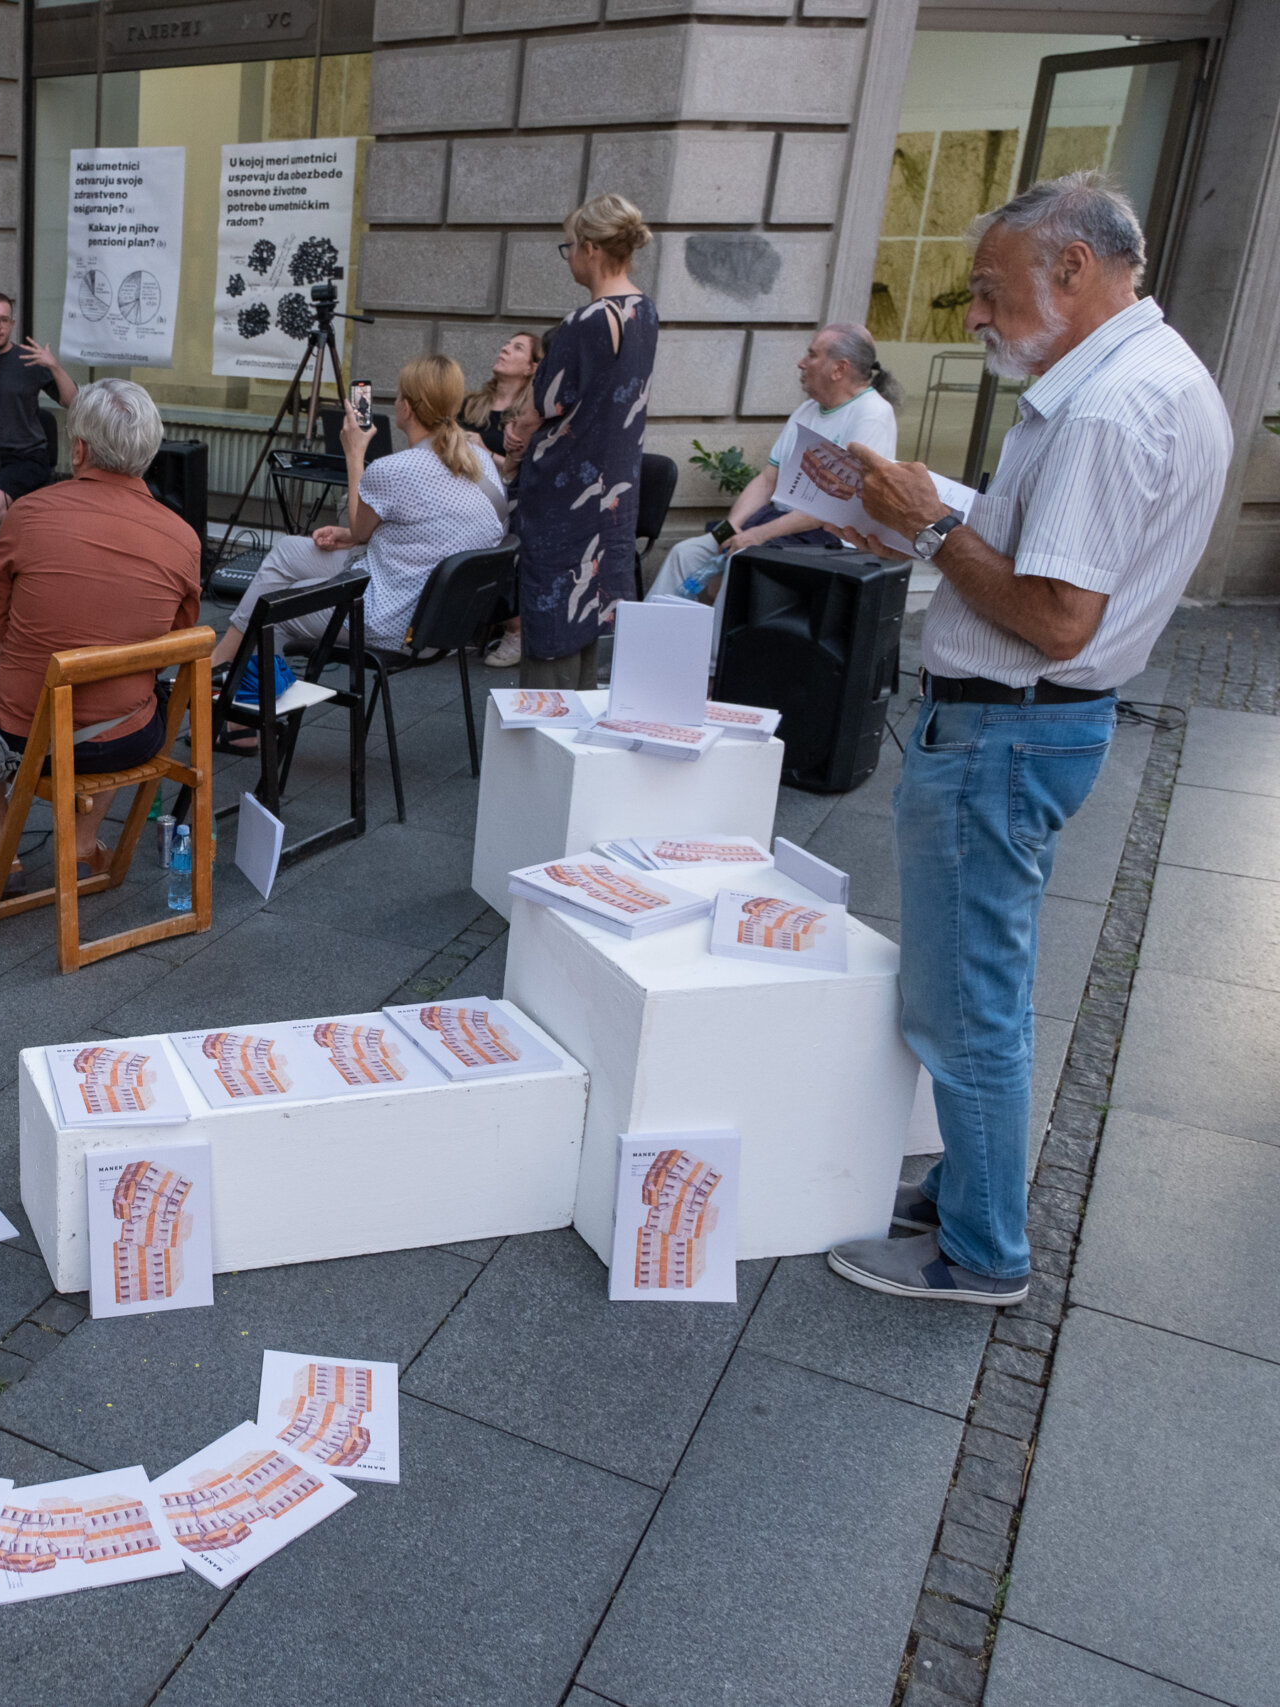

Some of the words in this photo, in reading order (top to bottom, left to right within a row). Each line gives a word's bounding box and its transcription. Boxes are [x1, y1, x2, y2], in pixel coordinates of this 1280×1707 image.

[76, 163, 95, 172] Kako
[96, 161, 140, 171] umetnici
[229, 157, 237, 168] U
[239, 156, 264, 169] kojoj
[265, 155, 289, 166] meri
[290, 152, 337, 165] umetnici
[75, 176, 115, 187] ostvaruju
[116, 176, 143, 187] svoje
[228, 171, 275, 184] uspevaju
[277, 171, 289, 181] da
[290, 168, 343, 180] obezbede
[74, 190, 128, 200] zdravstveno
[226, 188, 271, 198] osnovne
[272, 186, 307, 197] životne
[227, 202, 267, 214] potrebe
[268, 200, 330, 212] umetničkim
[226, 216, 264, 227] radom?
[88, 223, 116, 233] Kakav
[117, 223, 127, 235] je
[129, 223, 160, 235] njihov
[88, 236, 126, 248] penzioni
[127, 238, 155, 249] plan?
[788, 472, 803, 495] MANEK
[200, 1553, 224, 1572] MANEK
